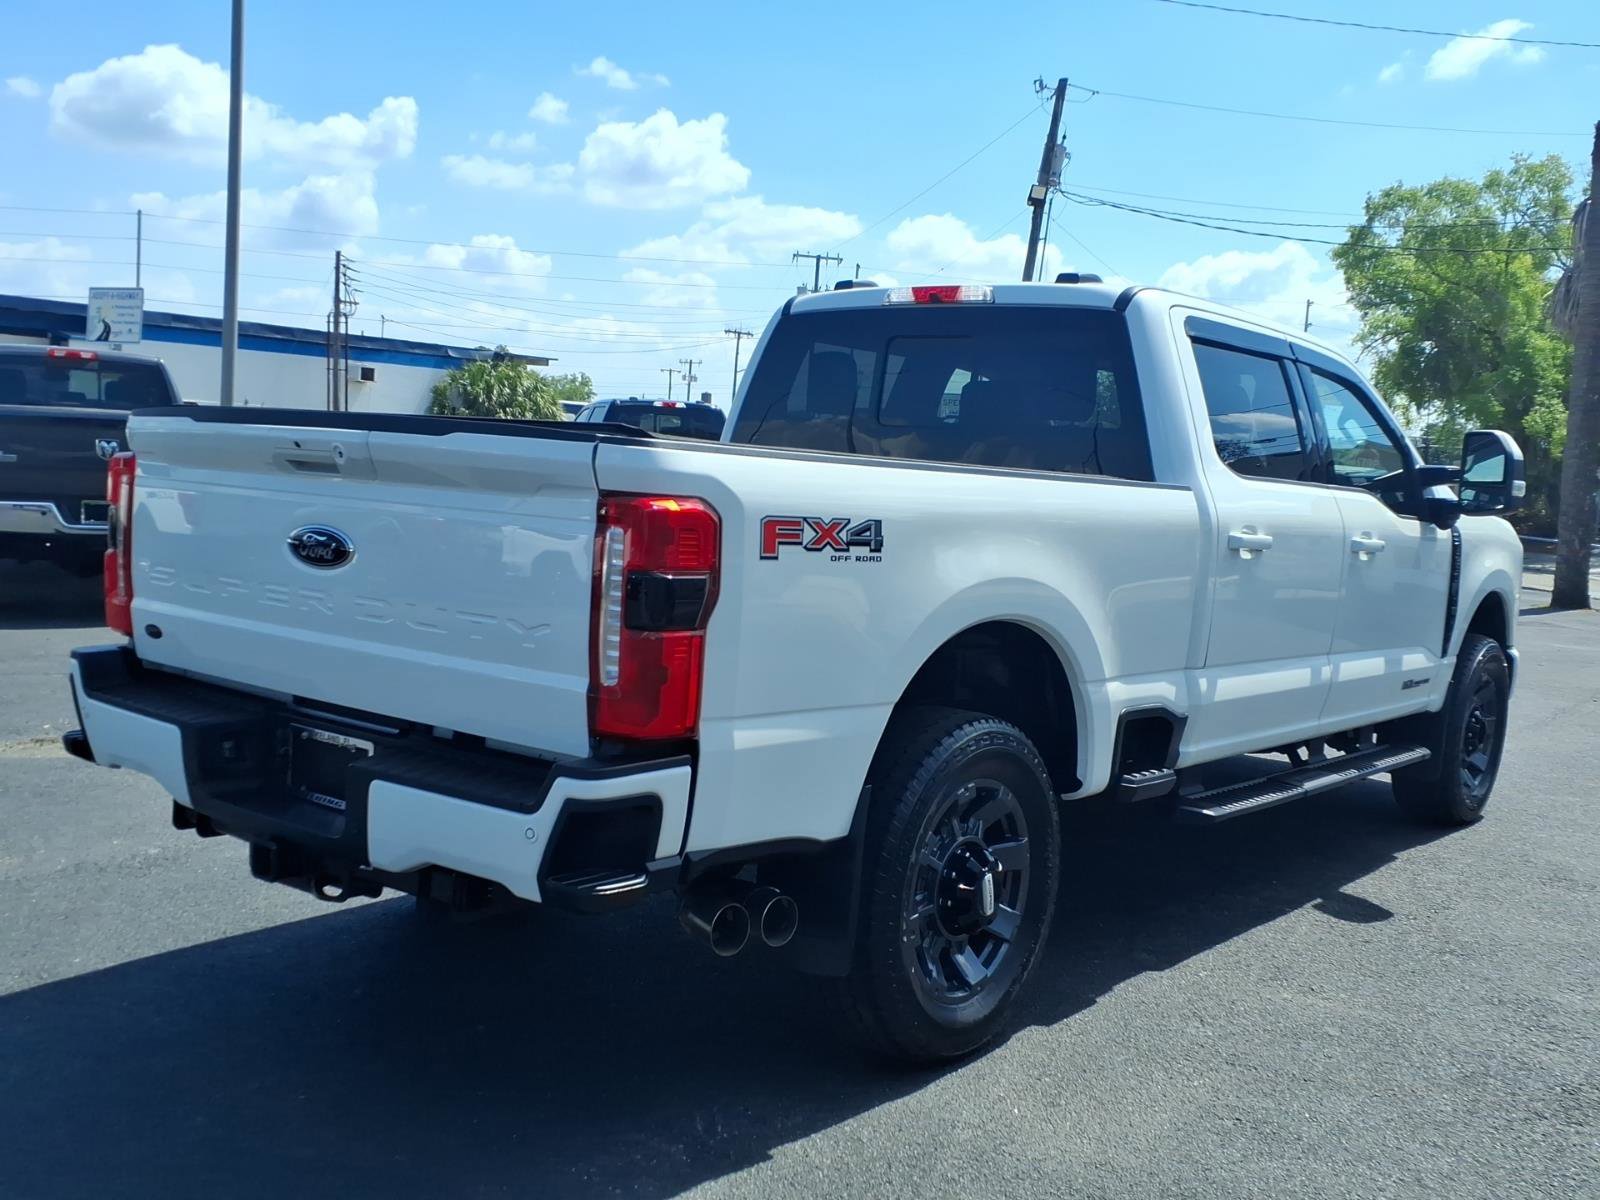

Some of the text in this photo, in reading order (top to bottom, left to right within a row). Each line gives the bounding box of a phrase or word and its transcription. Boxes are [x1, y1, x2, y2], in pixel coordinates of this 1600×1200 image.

[760, 515, 883, 560] FX4
[855, 555, 882, 563] ROAD
[148, 565, 552, 649] SUPER DUTY
